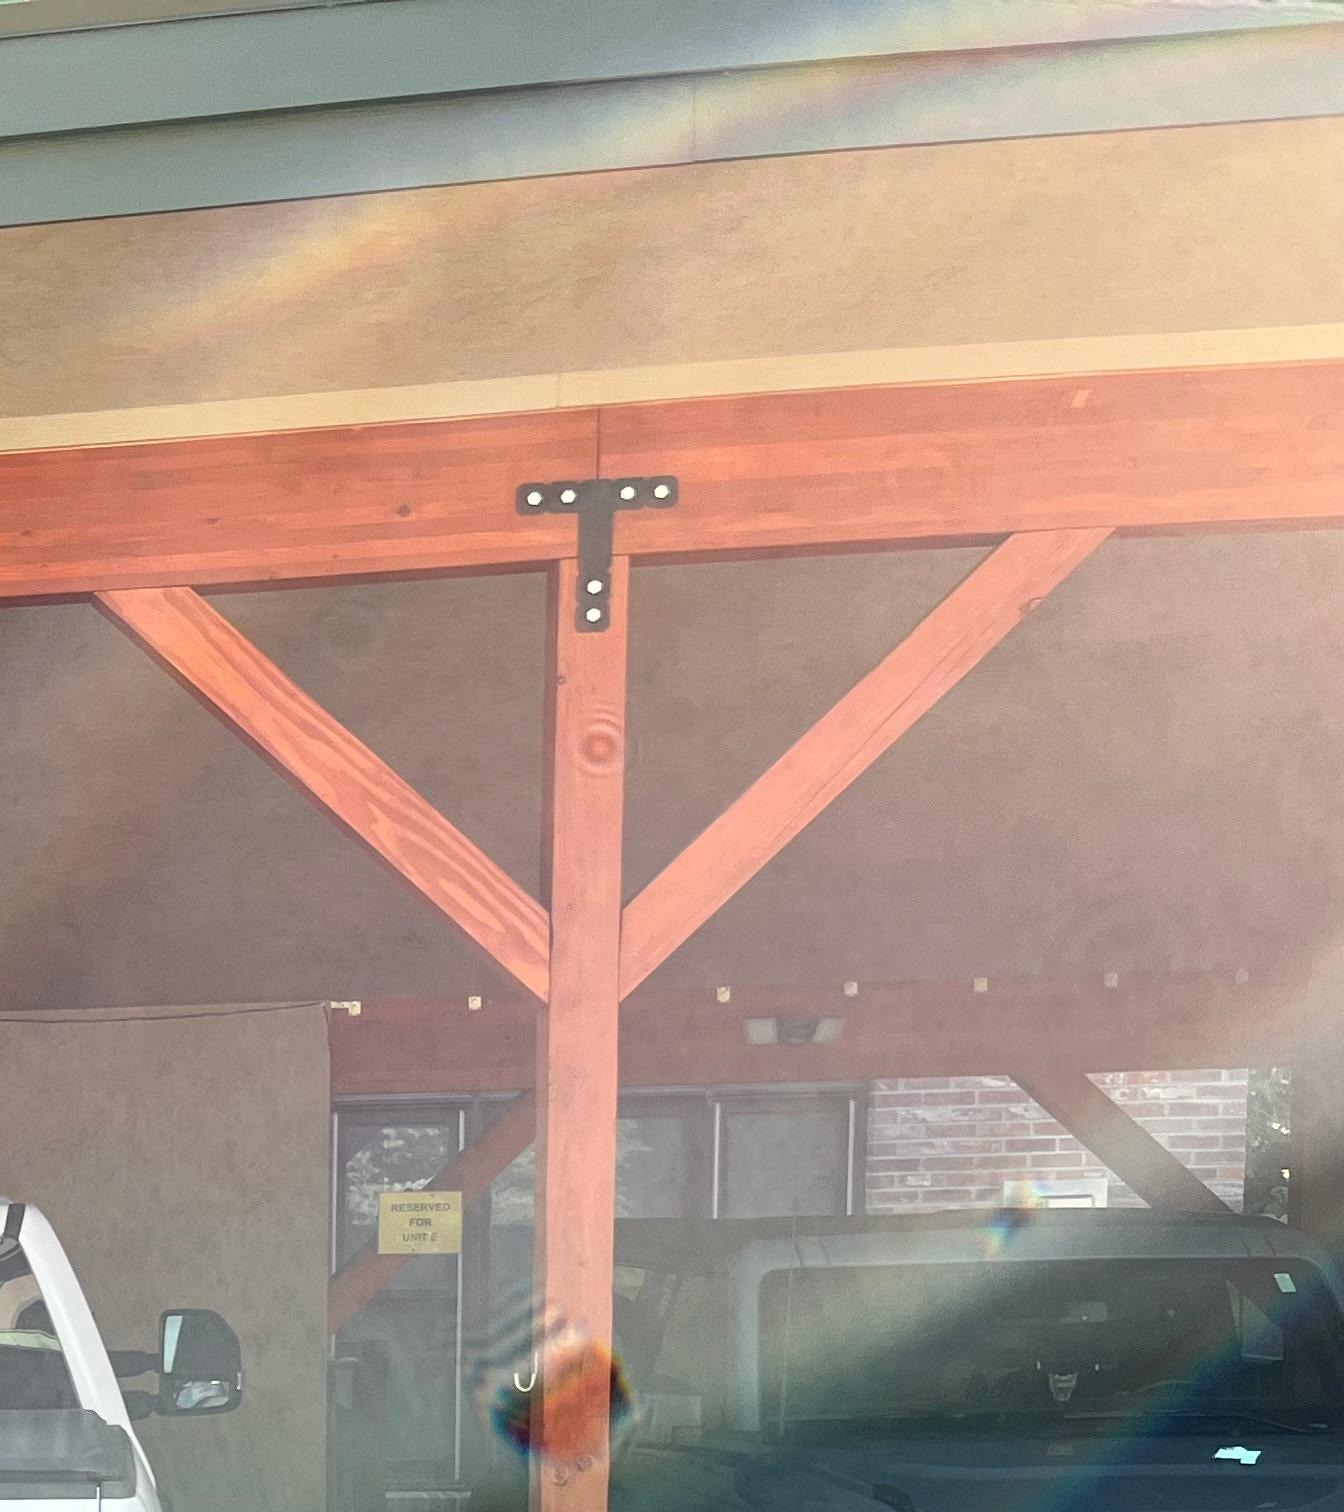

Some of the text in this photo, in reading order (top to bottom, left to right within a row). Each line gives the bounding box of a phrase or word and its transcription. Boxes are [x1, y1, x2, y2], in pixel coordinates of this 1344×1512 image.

[391, 1202, 450, 1213] RESERVED
[409, 1218, 432, 1227] FOR
[402, 1233, 427, 1242] UNIT
